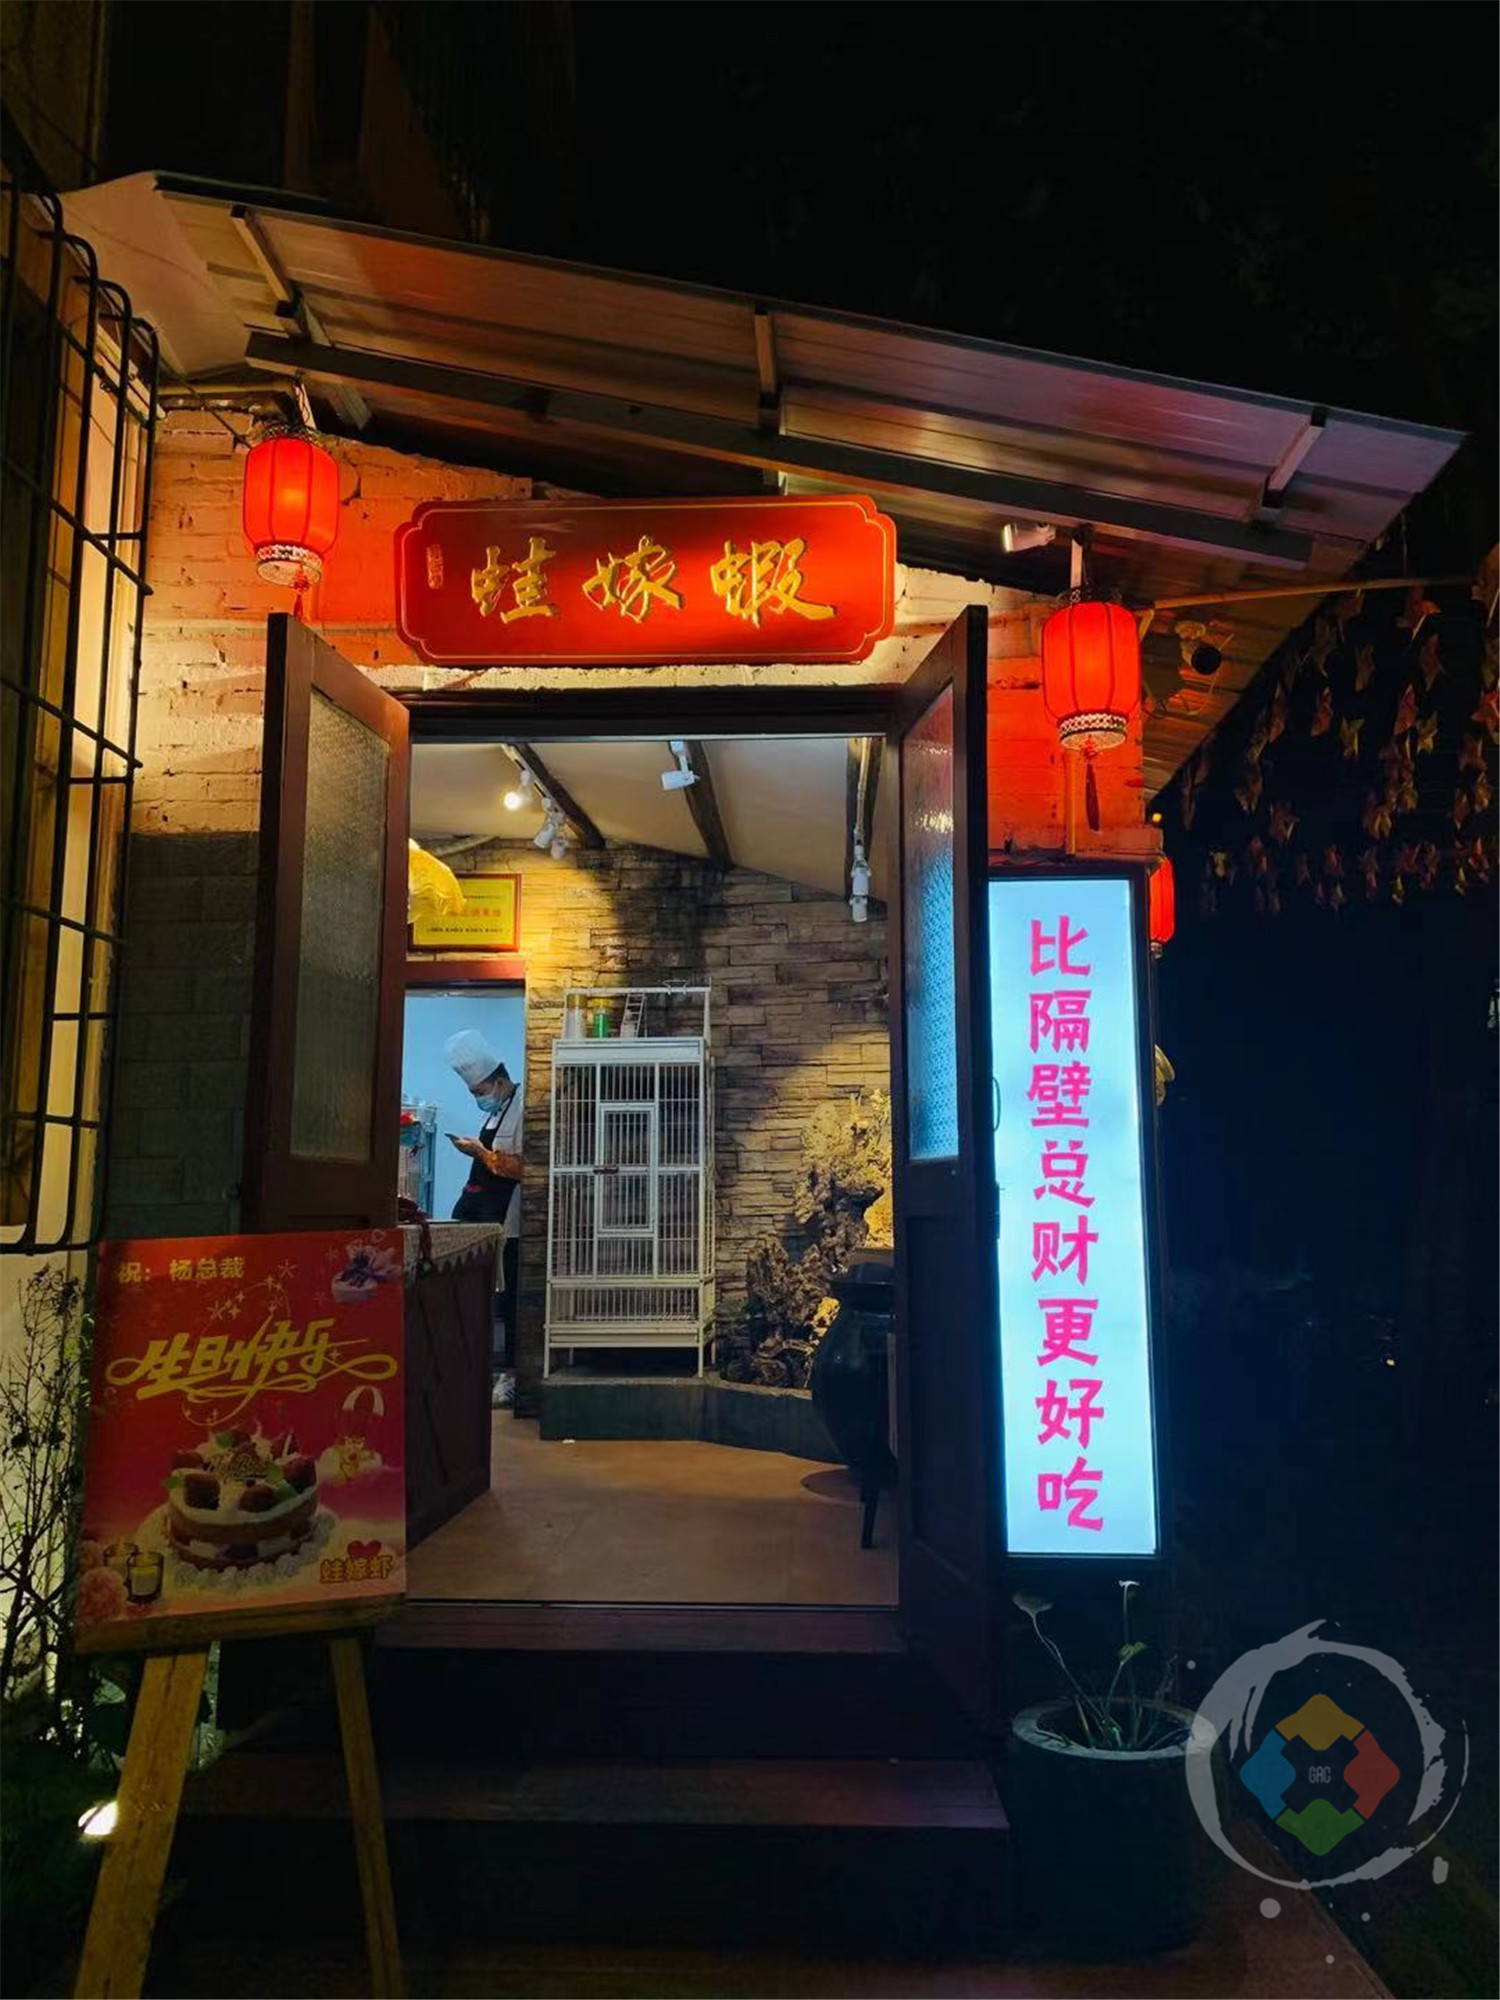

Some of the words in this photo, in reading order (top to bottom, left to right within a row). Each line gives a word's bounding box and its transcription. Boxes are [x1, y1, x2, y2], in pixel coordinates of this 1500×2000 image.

[1027, 916, 1104, 1531] 比隔壁总财更好吃
[168, 1256, 246, 1281] 杨总裁
[106, 1313, 397, 1401] 生日快乐
